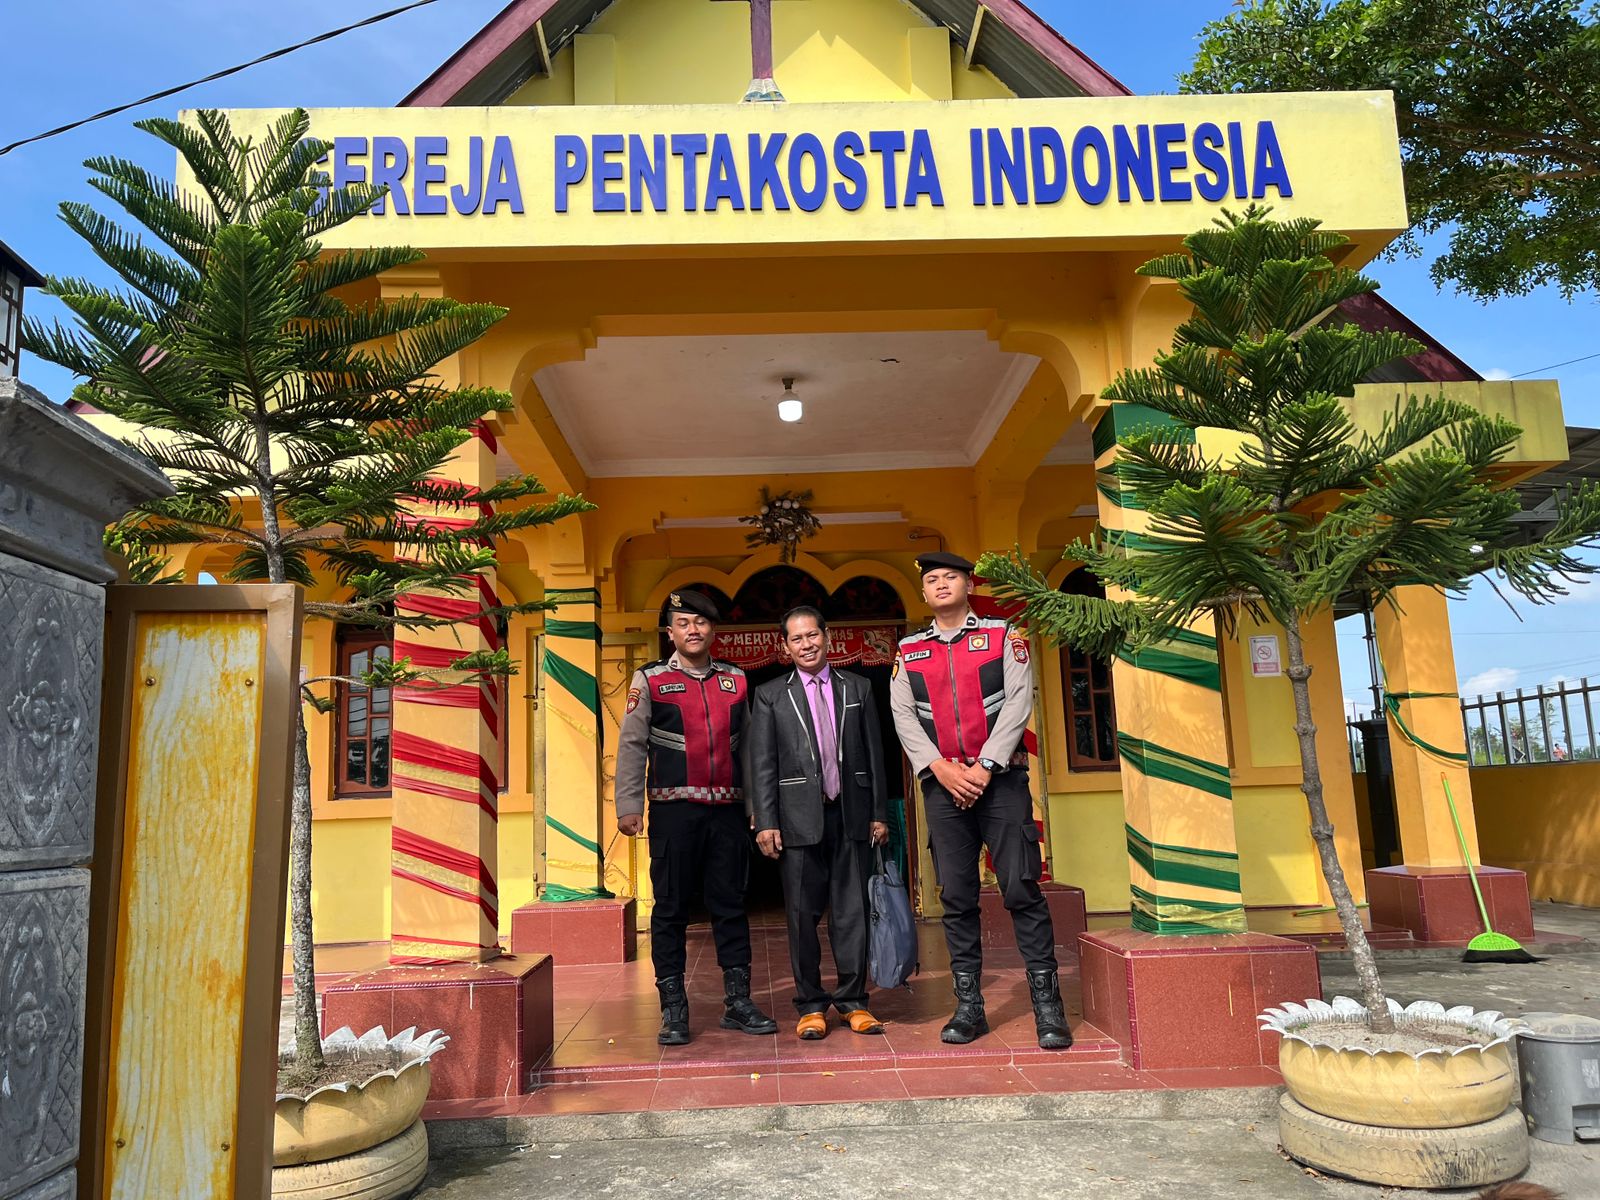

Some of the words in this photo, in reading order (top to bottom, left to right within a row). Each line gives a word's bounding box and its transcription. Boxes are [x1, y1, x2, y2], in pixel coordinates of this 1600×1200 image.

[554, 129, 944, 214] PENTAKOSTA
[969, 120, 1293, 206] INDONESIA
[733, 631, 779, 646] MERRY
